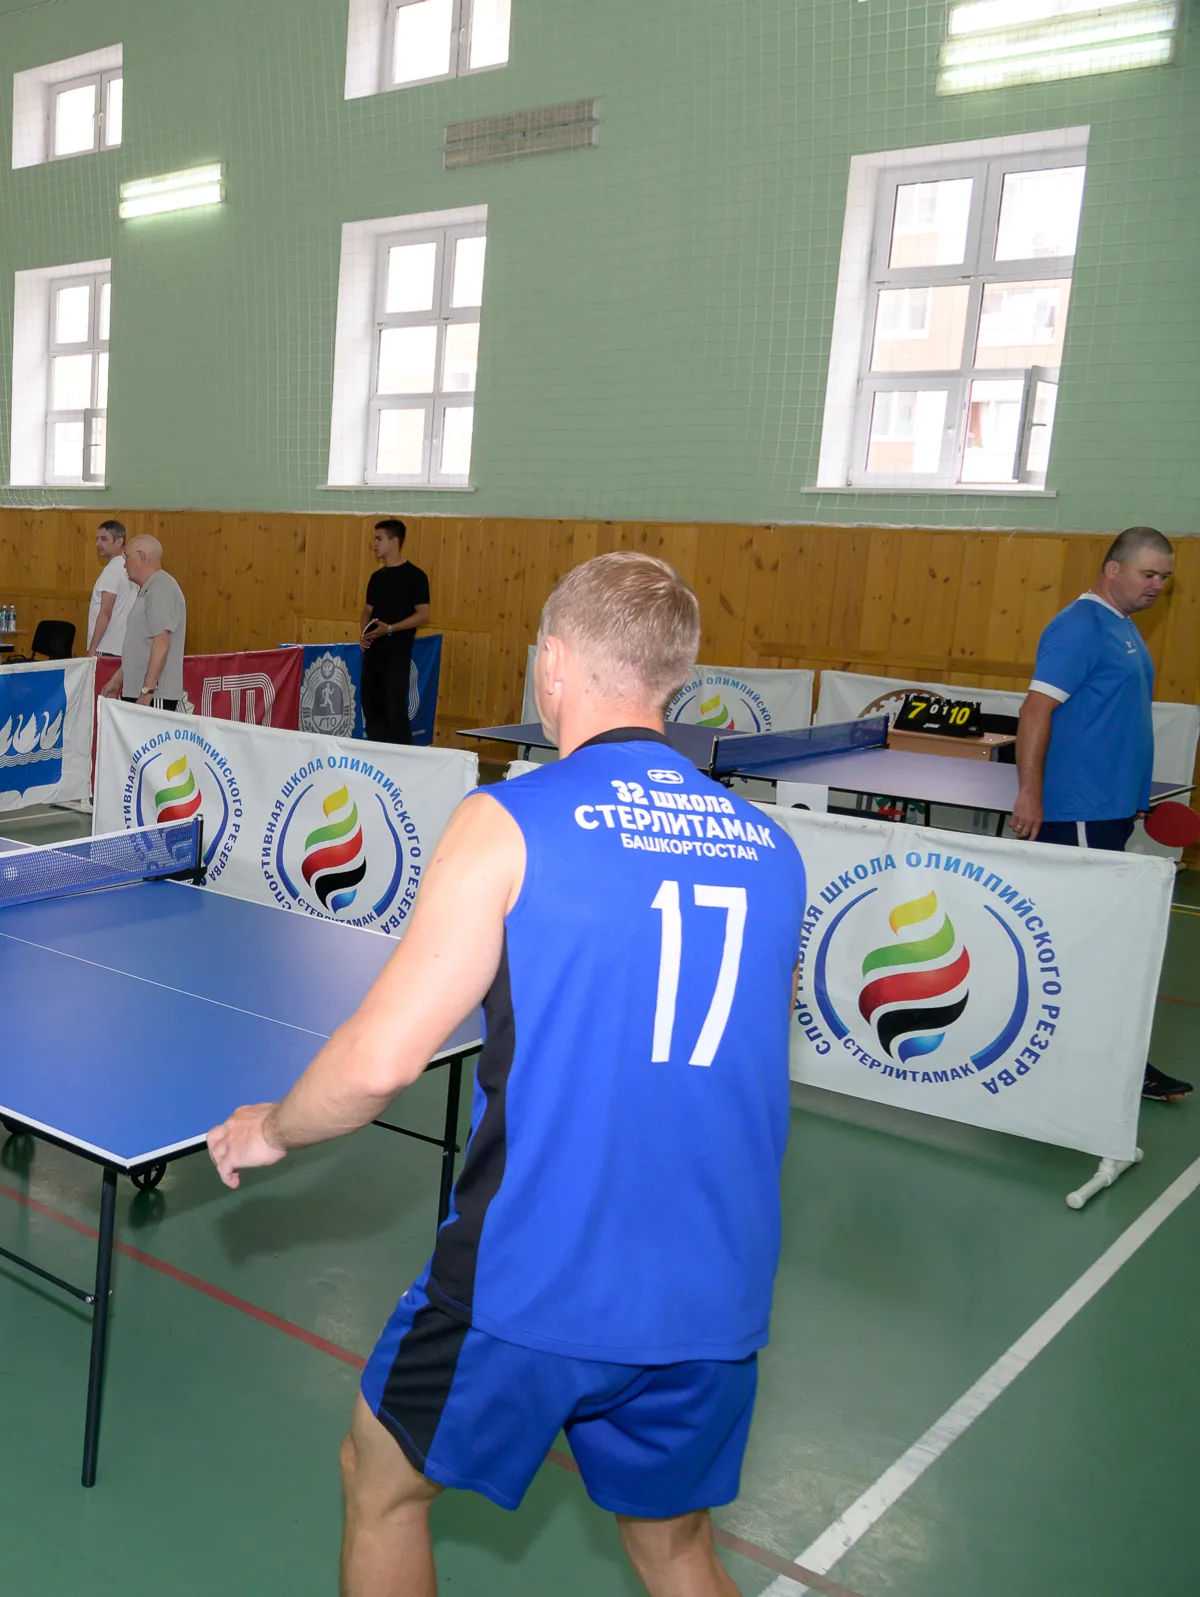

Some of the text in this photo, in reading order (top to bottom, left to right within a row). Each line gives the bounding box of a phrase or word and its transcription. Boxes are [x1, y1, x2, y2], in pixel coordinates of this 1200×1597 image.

[908, 702, 927, 718] 7
[929, 704, 939, 714] 0
[948, 706, 970, 724] 10
[133, 731, 171, 764] ШКОЛА
[174, 730, 243, 818] ОЛИМПИЙСКОГО
[209, 823, 240, 882] РЕЗЕРВА
[610, 780, 736, 814] 32 школа
[281, 758, 324, 798] ШКОЛА
[328, 756, 422, 858] ОЛИМПИЙСКОГО
[380, 864, 421, 934] РЕЗЕРВА
[574, 804, 776, 849] СТЕРЛИТАМАК
[620, 832, 758, 861] БАШКОРТОСТАН
[819, 854, 896, 904] ШКОЛА
[905, 852, 1062, 996] ОЛИМПИЙСКОГО
[650, 880, 748, 1067] 17
[842, 1037, 976, 1084] СТЕРЛИТАМАК
[981, 1004, 1060, 1095] РЕЗЕРВА
